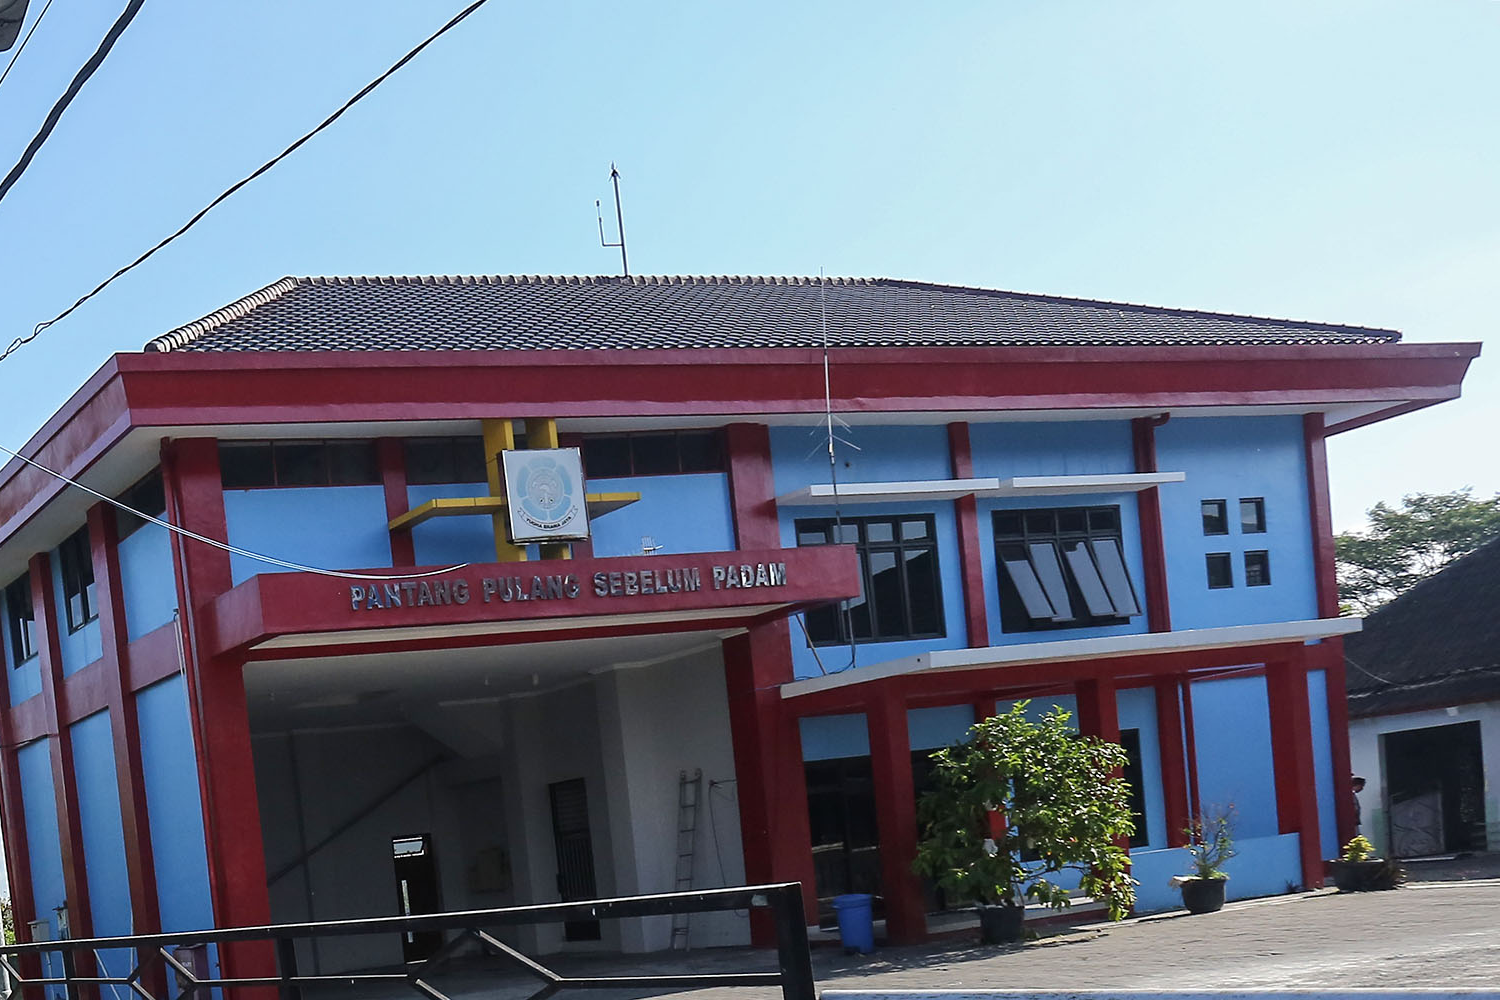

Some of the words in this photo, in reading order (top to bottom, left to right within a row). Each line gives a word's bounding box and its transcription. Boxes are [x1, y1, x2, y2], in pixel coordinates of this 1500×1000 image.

[350, 579, 470, 610] PANTANG
[483, 573, 581, 602] PULANG
[594, 567, 701, 597] SEBELUM
[712, 562, 787, 590] PADAM
